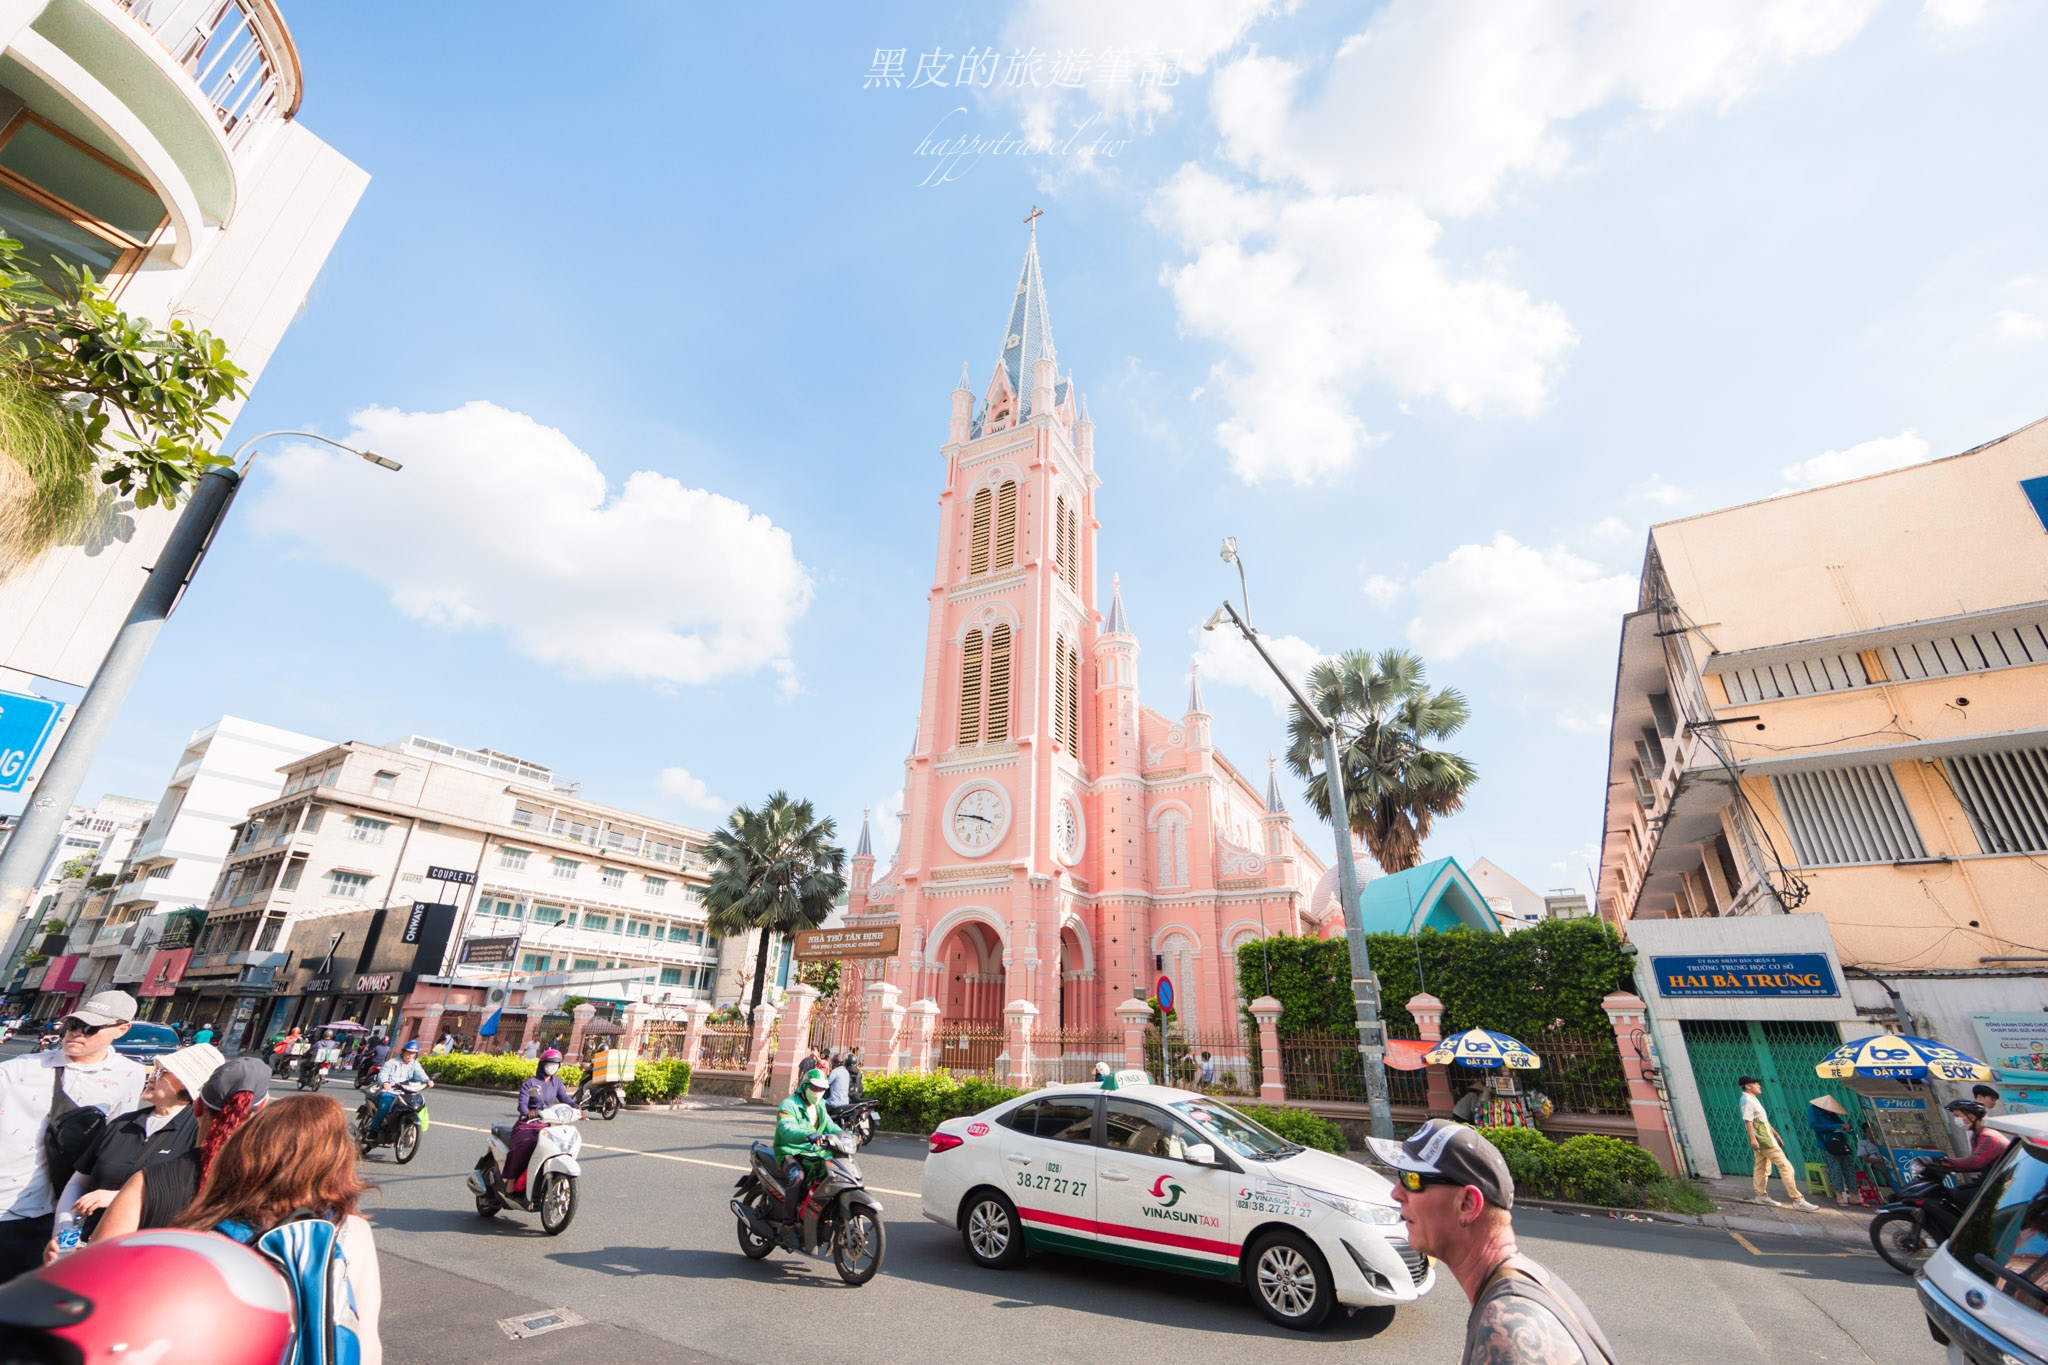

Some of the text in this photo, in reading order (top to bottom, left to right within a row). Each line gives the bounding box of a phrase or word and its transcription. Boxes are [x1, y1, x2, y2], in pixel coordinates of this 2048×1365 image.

[432, 868, 476, 884] COUPLE TX
[406, 904, 425, 941] ONWAYS
[808, 933, 824, 943] NHÀ
[845, 932, 861, 941] TÂN
[357, 976, 392, 991] ONWAYS
[1668, 972, 1822, 988] HAI BÀ TRƯNG
[1440, 1038, 1459, 1050] be
[1464, 1039, 1492, 1053] be
[1493, 1038, 1522, 1051] be
[1835, 1045, 1858, 1058] be
[1870, 1045, 1910, 1060] be
[1915, 1045, 1959, 1060] be
[1510, 1057, 1532, 1068] 50K
[1873, 1066, 1912, 1078] ĐẶT XE
[1943, 1065, 1980, 1079] 50K
[1046, 1162, 1062, 1174] (028)
[1016, 1172, 1088, 1198] 38.27 27 27
[1255, 1194, 1311, 1208] VINASUN TAXI
[1252, 1201, 1281, 1214] 38.27
[1283, 1206, 1297, 1216] 27
[1299, 1208, 1312, 1218] 27
[1142, 1206, 1220, 1228] VINASUN TAXI
